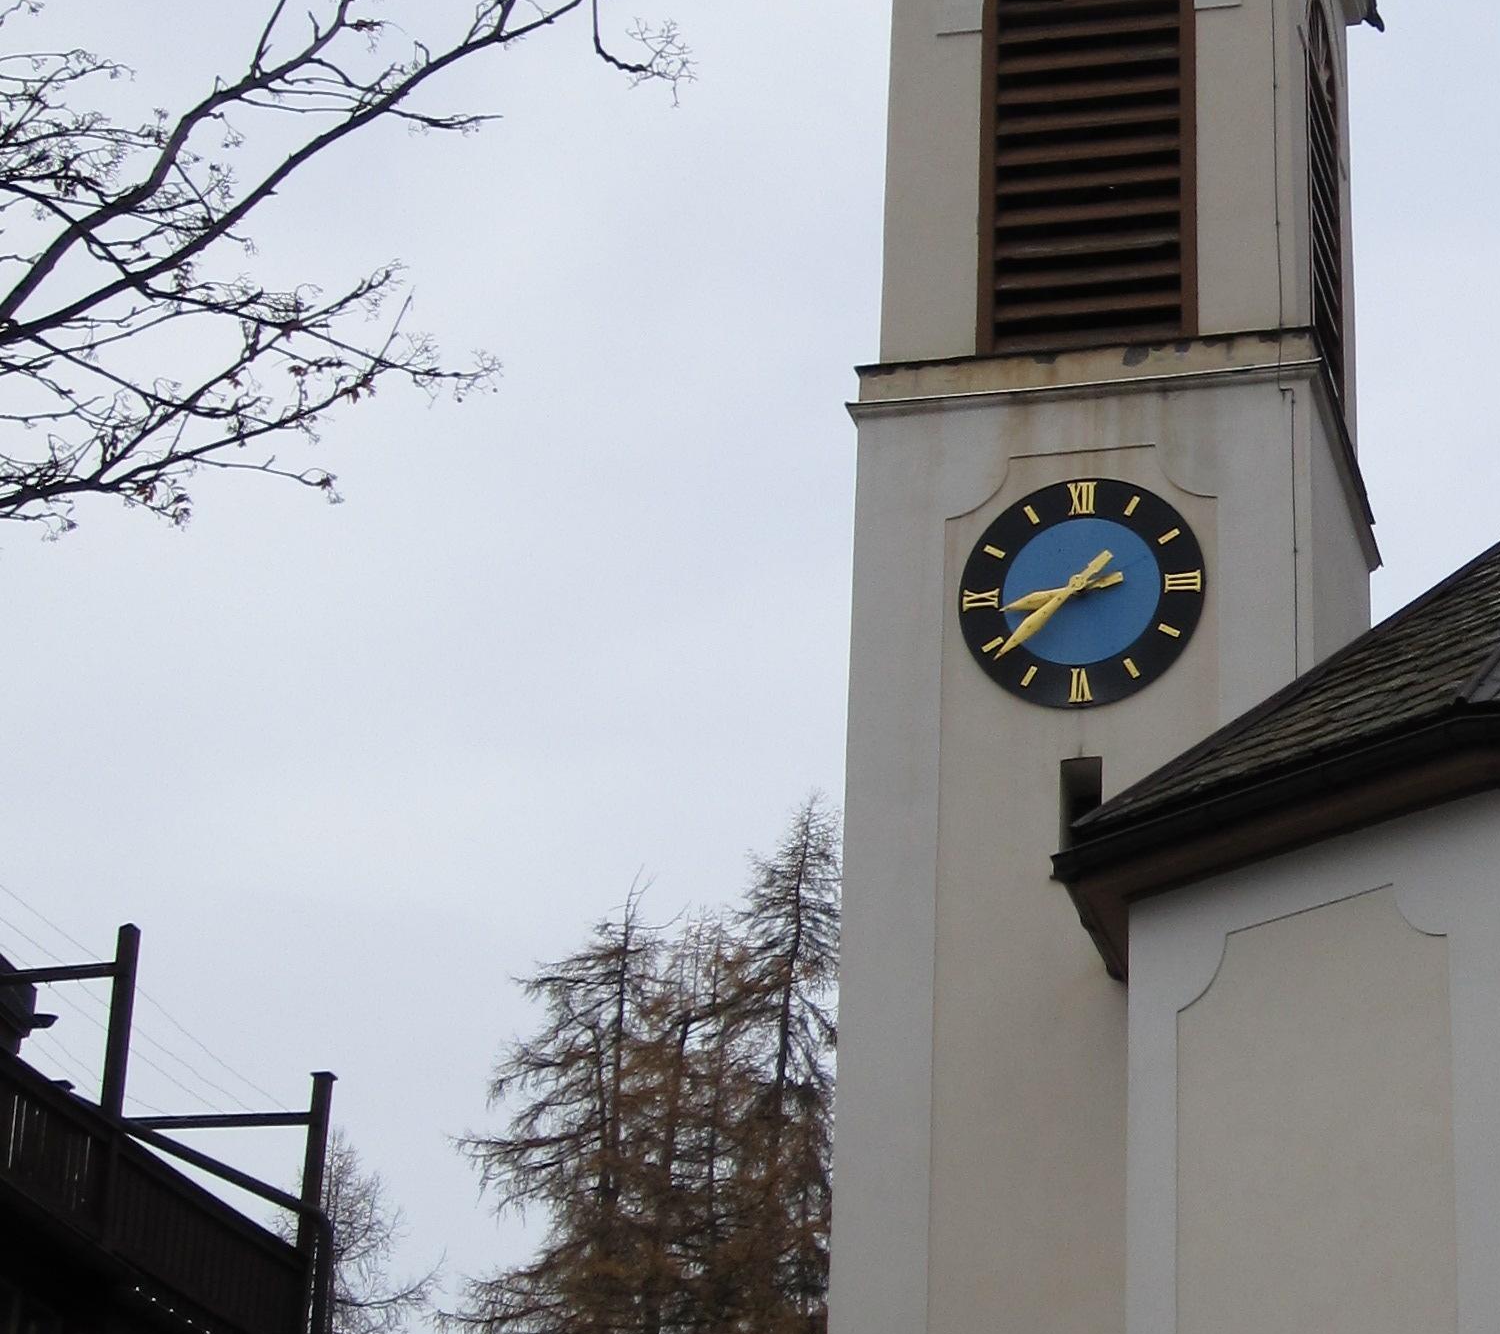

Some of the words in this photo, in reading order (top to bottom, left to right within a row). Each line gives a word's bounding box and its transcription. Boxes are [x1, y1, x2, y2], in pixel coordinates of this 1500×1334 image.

[1066, 481, 1097, 515] XII
[1164, 568, 1201, 593] III
[962, 588, 999, 612] IX
[1068, 667, 1093, 703] VI
